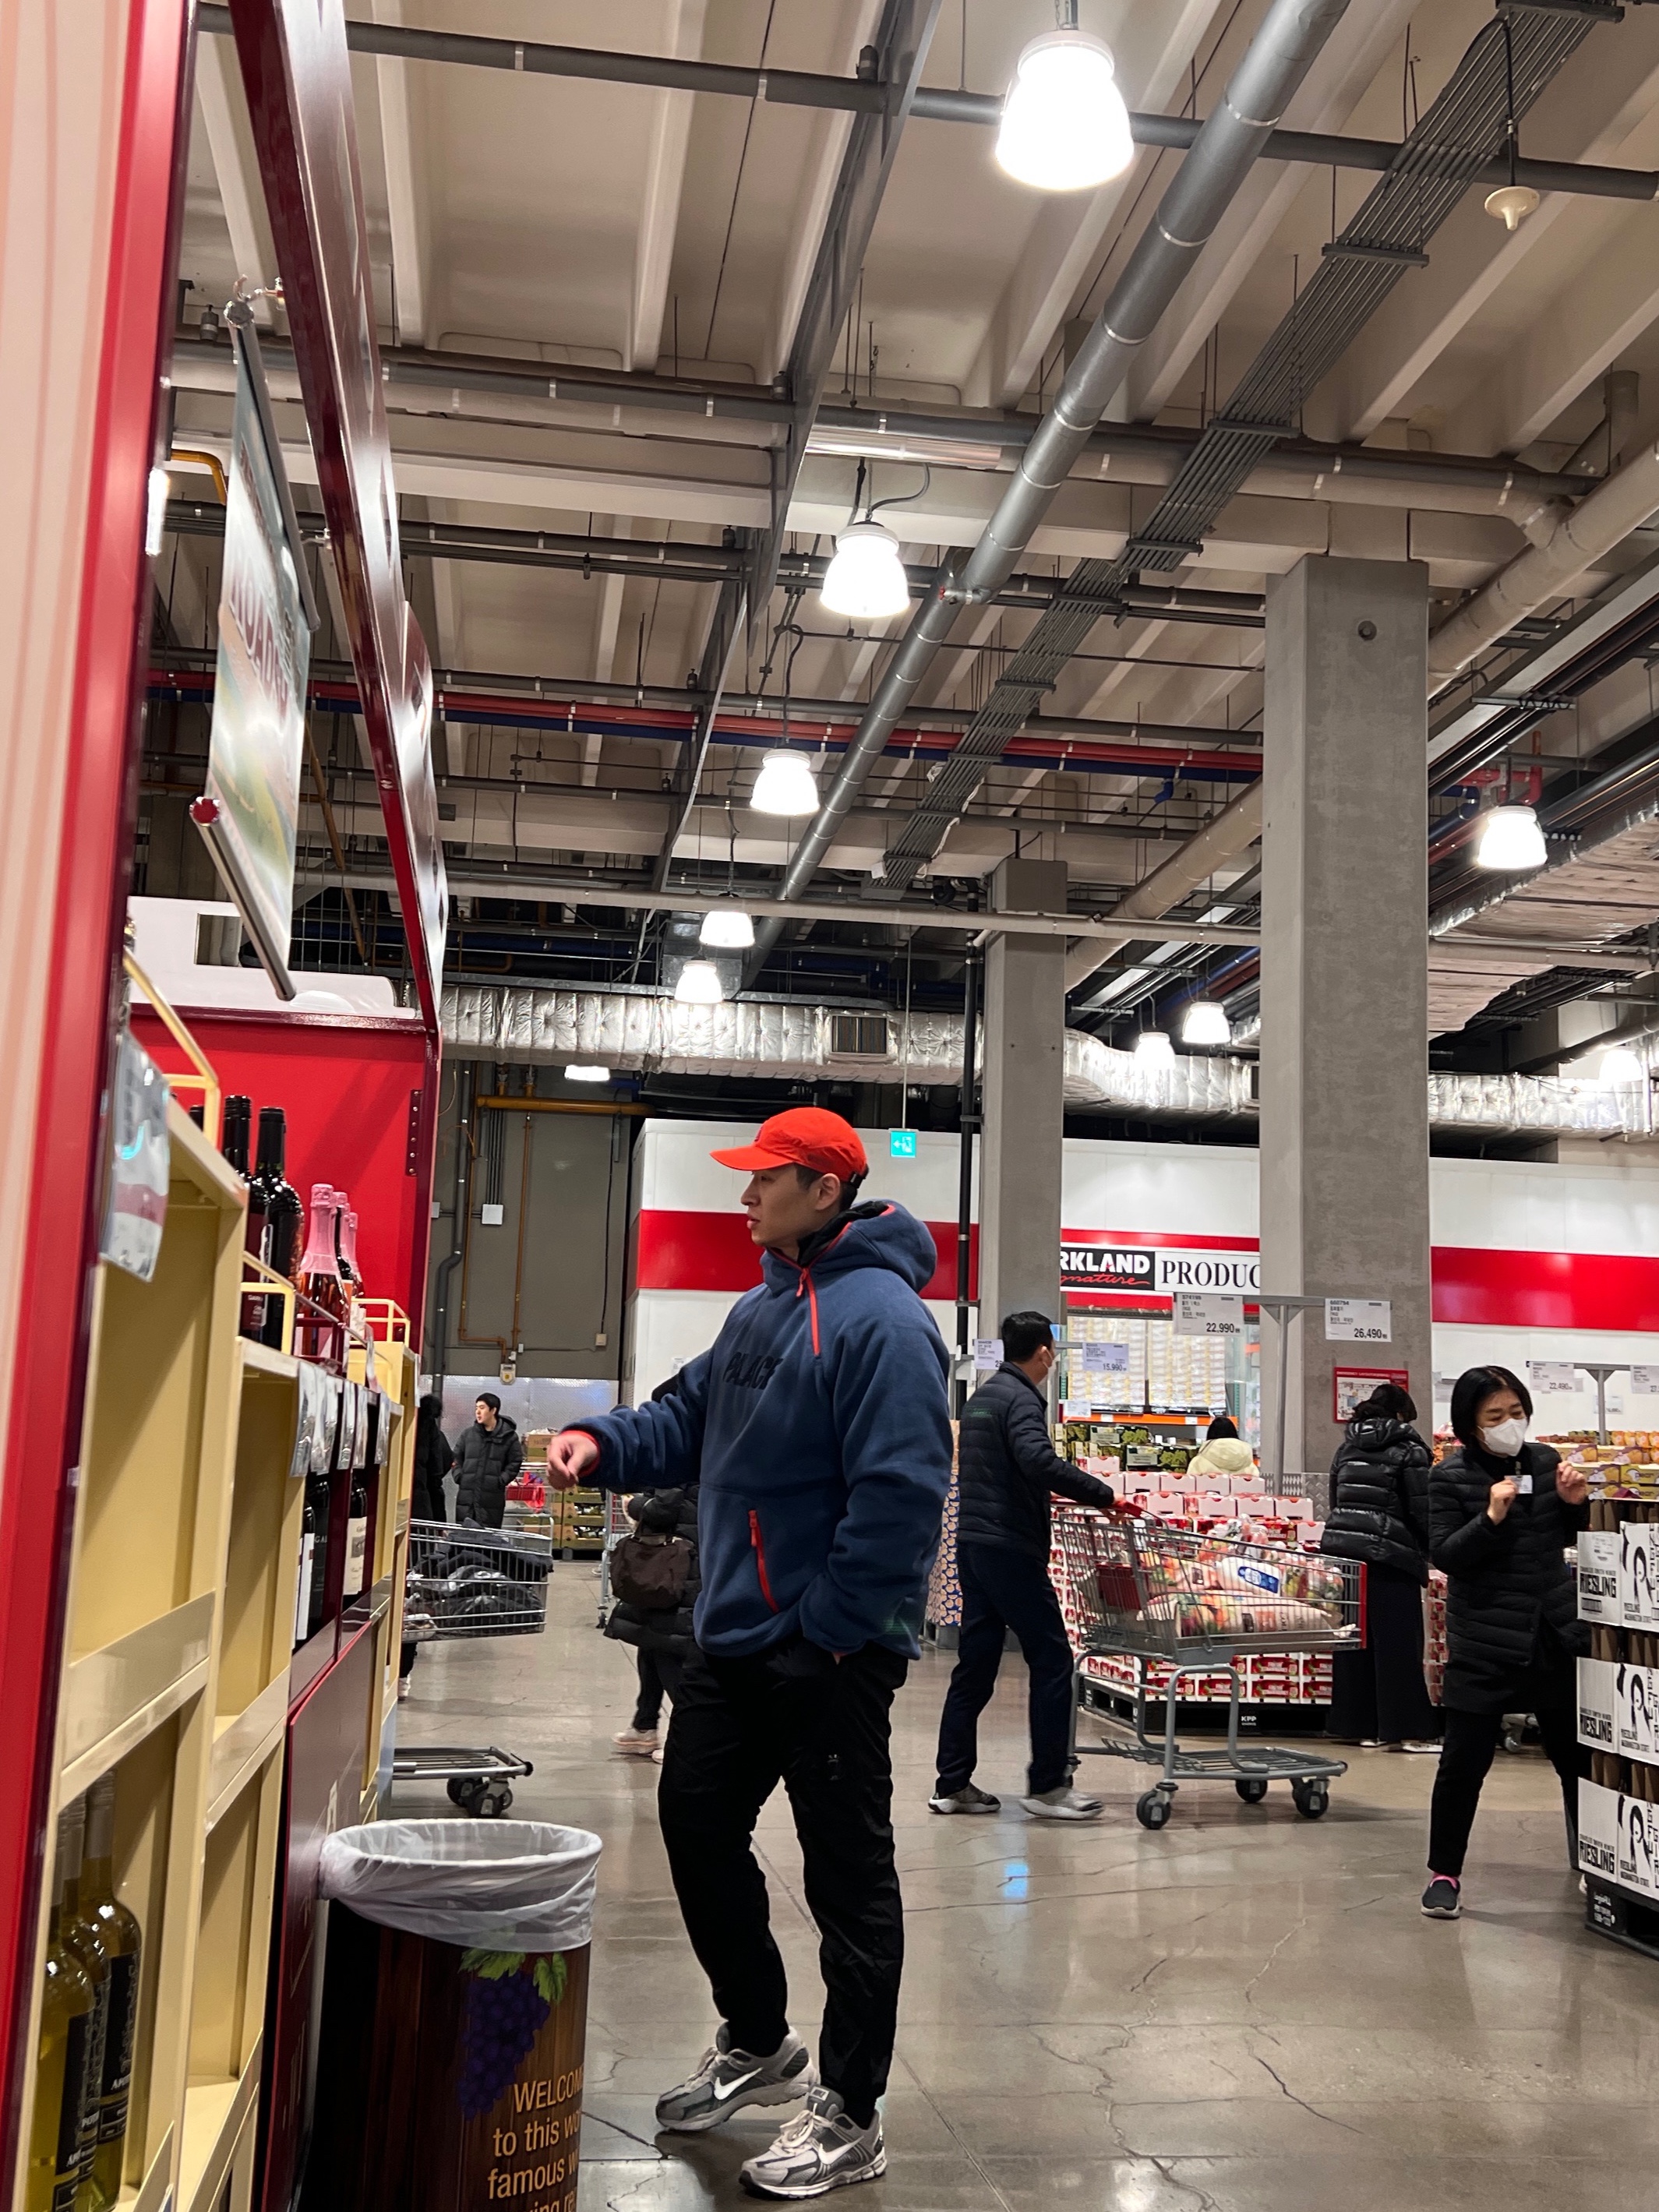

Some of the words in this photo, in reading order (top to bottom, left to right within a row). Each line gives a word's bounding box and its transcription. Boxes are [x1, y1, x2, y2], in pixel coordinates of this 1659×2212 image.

[492, 2127, 517, 2157] to
[524, 2116, 560, 2152] this
[487, 2157, 565, 2200] famous
